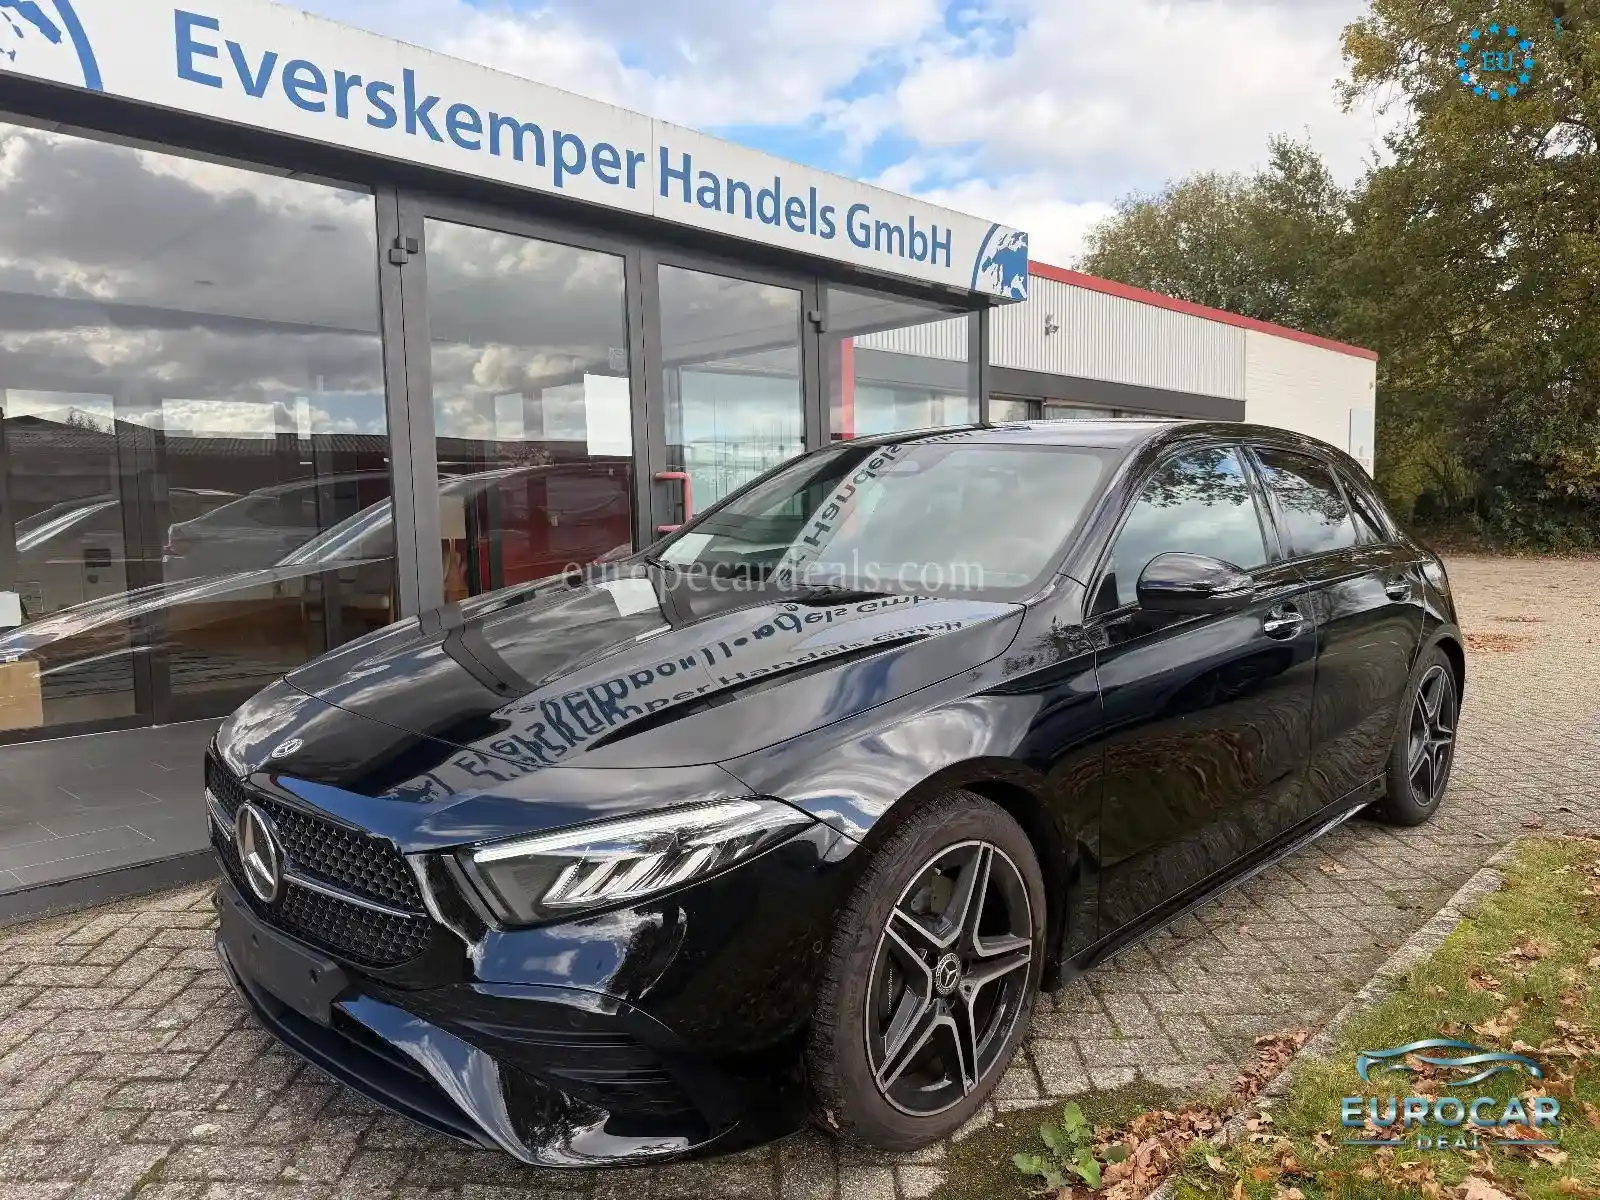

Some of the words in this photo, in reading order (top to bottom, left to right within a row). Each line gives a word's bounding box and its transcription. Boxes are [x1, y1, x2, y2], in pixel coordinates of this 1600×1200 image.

[174, 9, 645, 189] Everskemper
[660, 146, 836, 239] Handels
[846, 203, 951, 267] GmbH
